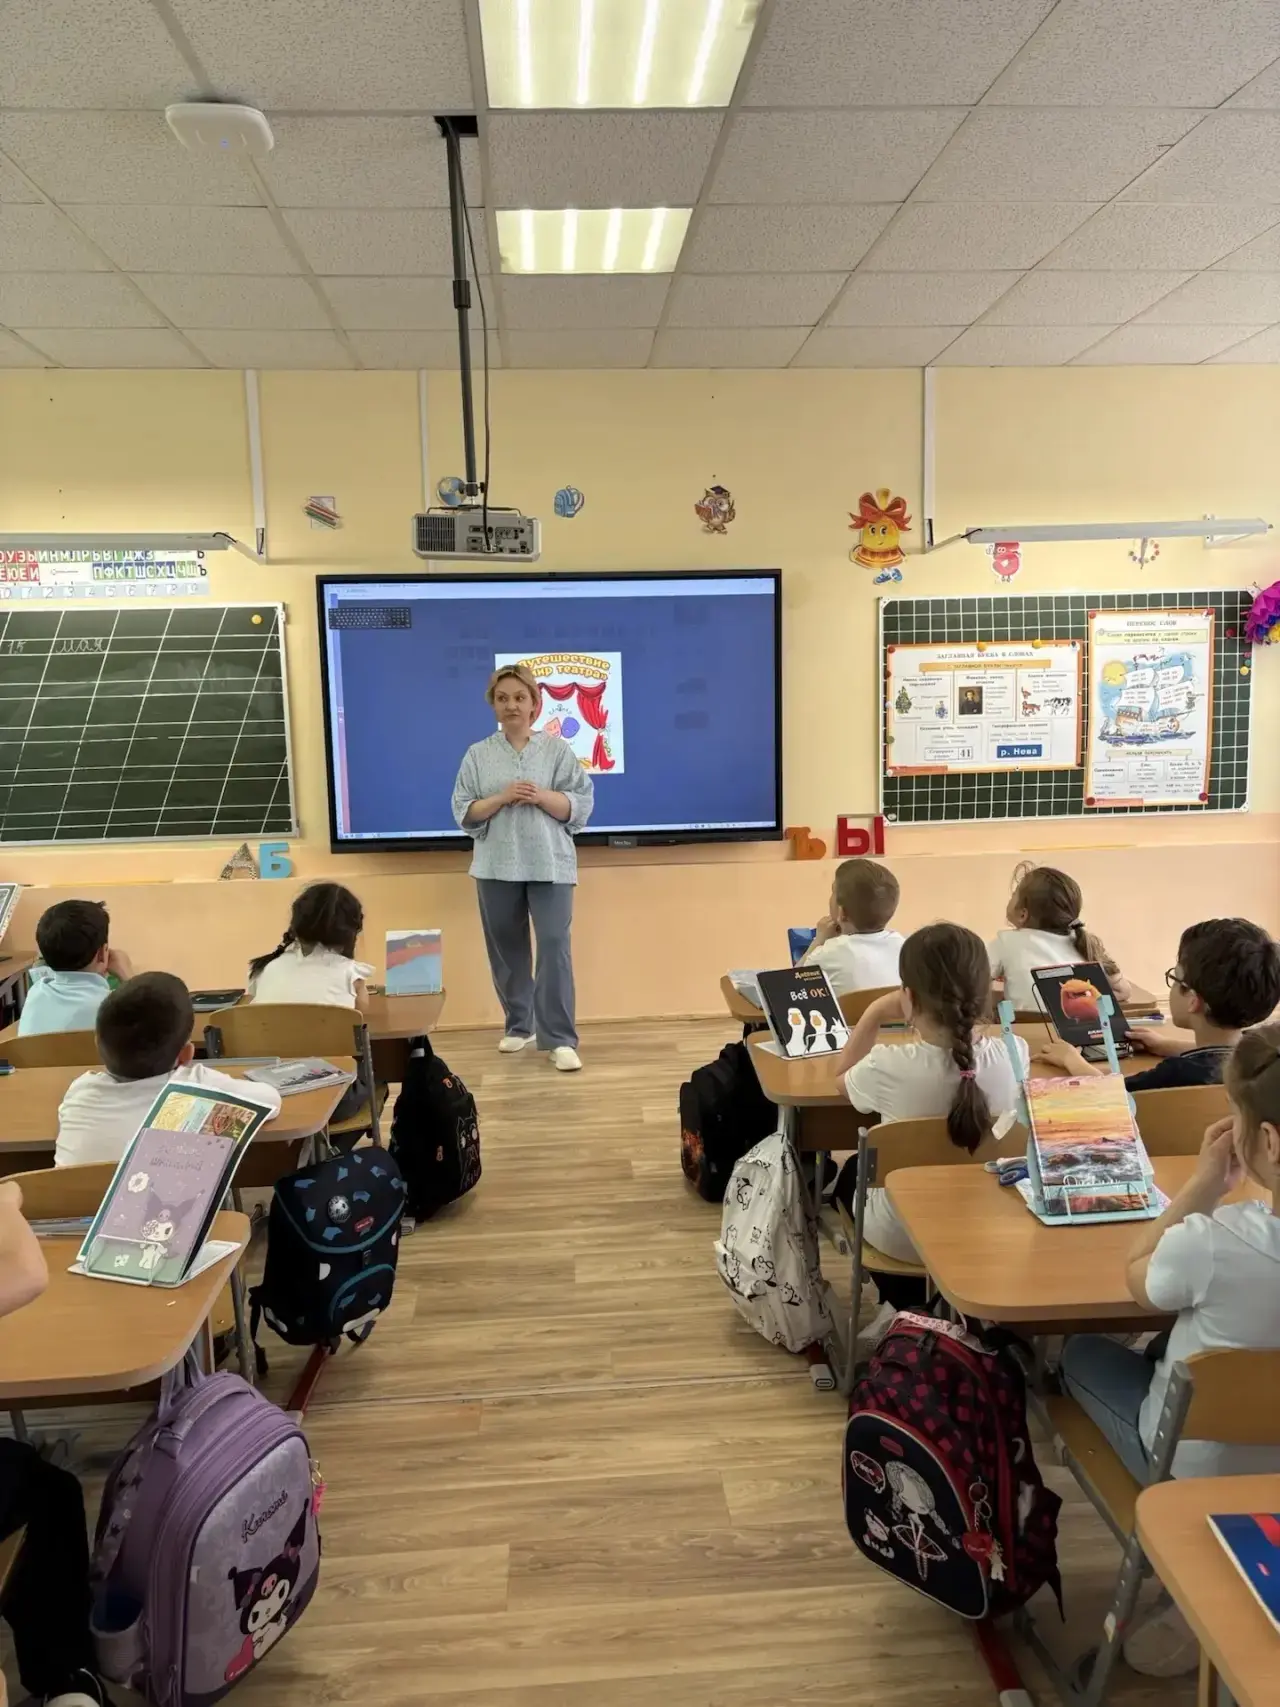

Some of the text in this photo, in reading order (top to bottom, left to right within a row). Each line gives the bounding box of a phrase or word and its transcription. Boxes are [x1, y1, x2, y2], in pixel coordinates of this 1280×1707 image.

[518, 654, 610, 671] Путешествие
[837, 813, 884, 856] Ы
[790, 987, 809, 1001] Всё
